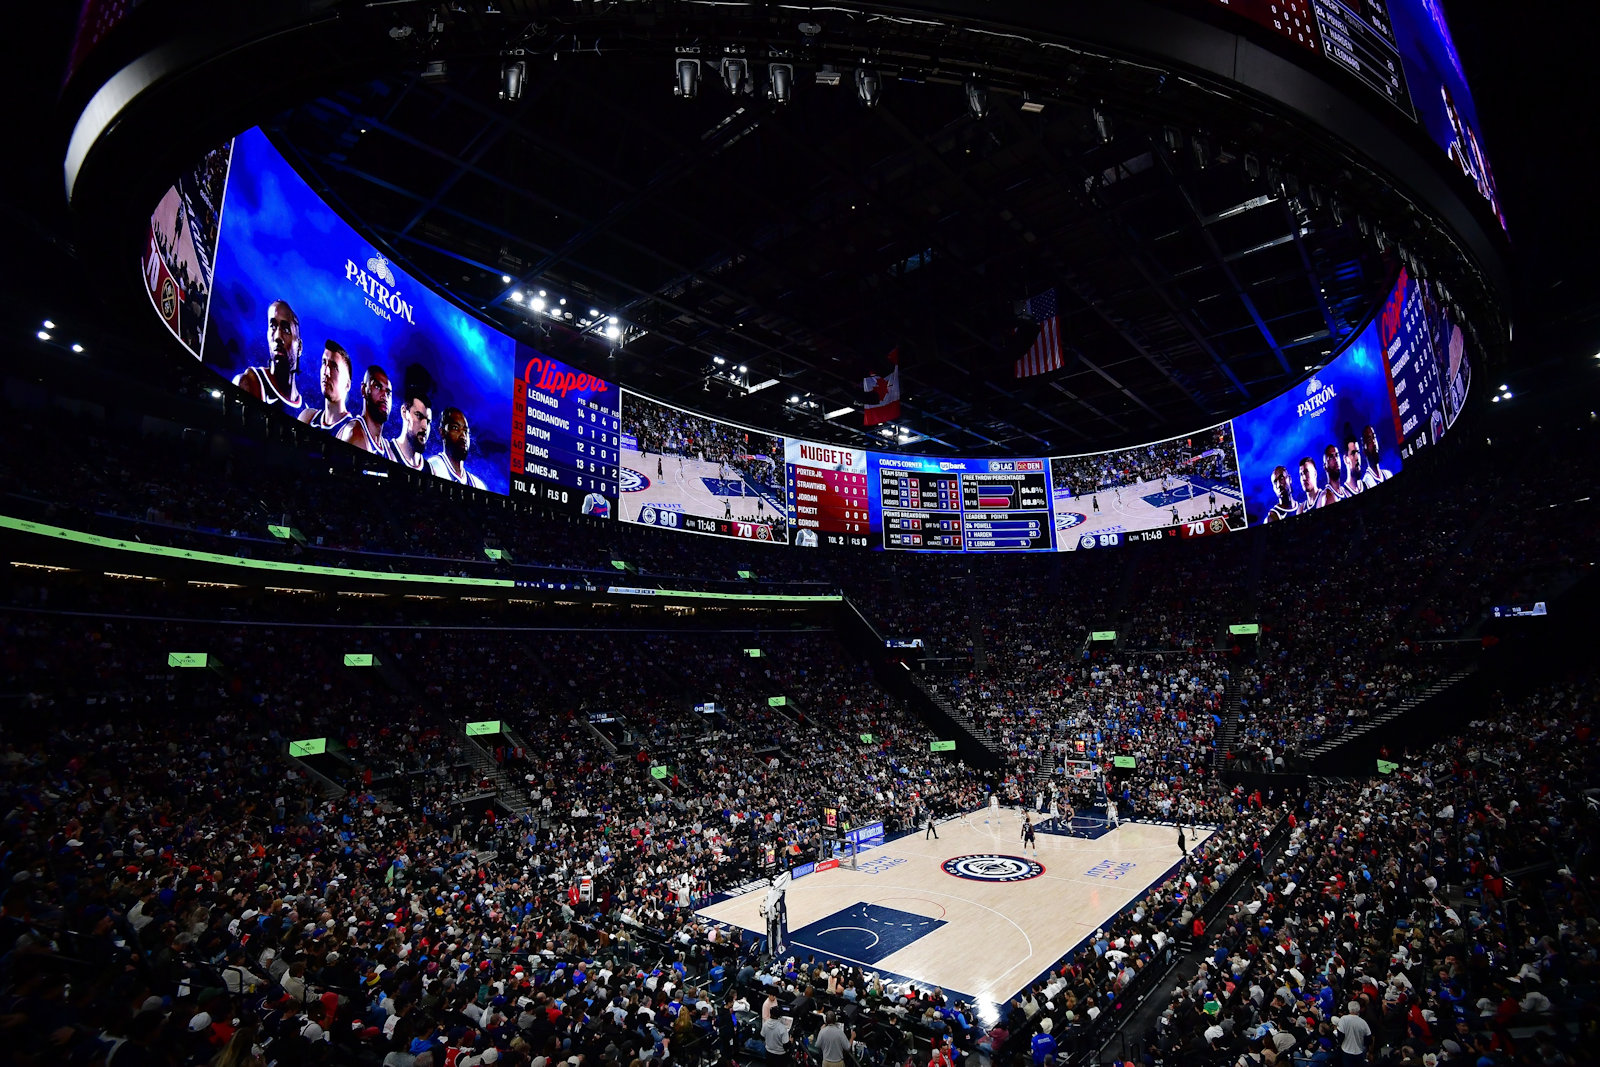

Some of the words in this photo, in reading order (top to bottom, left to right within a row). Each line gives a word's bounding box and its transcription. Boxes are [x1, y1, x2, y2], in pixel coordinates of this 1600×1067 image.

[1326, 41, 1331, 52] 2
[345, 259, 412, 323] PATRÓN
[364, 297, 391, 322] TEQUILA
[525, 357, 608, 398] Clippers
[528, 388, 558, 408] LEONARD
[578, 408, 585, 418] 14
[591, 414, 596, 422] 9
[602, 418, 606, 426] 4
[612, 421, 618, 430] 0
[1297, 384, 1334, 417] PATRÓN
[528, 406, 570, 430] BOGDANOVIC
[578, 426, 583, 435] 0
[592, 430, 595, 438] 1
[602, 434, 606, 442] 3
[612, 437, 618, 446] 0
[527, 425, 550, 441] BATUM
[577, 442, 584, 452] 12
[590, 446, 595, 455] 5
[601, 450, 606, 458] 0
[613, 453, 616, 462] 1
[526, 443, 548, 458] ZUBAC
[576, 459, 584, 469] 13
[590, 463, 595, 472] 5
[602, 467, 605, 475] 1
[612, 469, 617, 478] 2
[800, 444, 852, 466] NUGGETS
[879, 458, 901, 467] COACH'S
[525, 462, 548, 477] JONES
[548, 469, 559, 480] JR.
[577, 477, 582, 486] 5
[591, 480, 594, 489] 1
[601, 483, 606, 491] 0
[613, 486, 616, 494] 1
[797, 468, 815, 477] PORTER
[514, 480, 527, 492] TOL
[530, 484, 536, 496] 4
[548, 489, 559, 500] FLS
[562, 492, 568, 503] 0
[797, 480, 826, 491] STRAWTHER
[797, 493, 818, 502] JORDAN
[798, 506, 818, 515] PICKETT
[660, 511, 677, 527] 90
[698, 520, 715, 532] 11:48
[737, 524, 752, 537] 70
[1100, 534, 1118, 546] 90
[1141, 530, 1162, 542] 11:48
[1187, 522, 1205, 536] 70
[839, 537, 844, 545] 2
[862, 538, 867, 546] 0
[827, 814, 837, 826] 12
